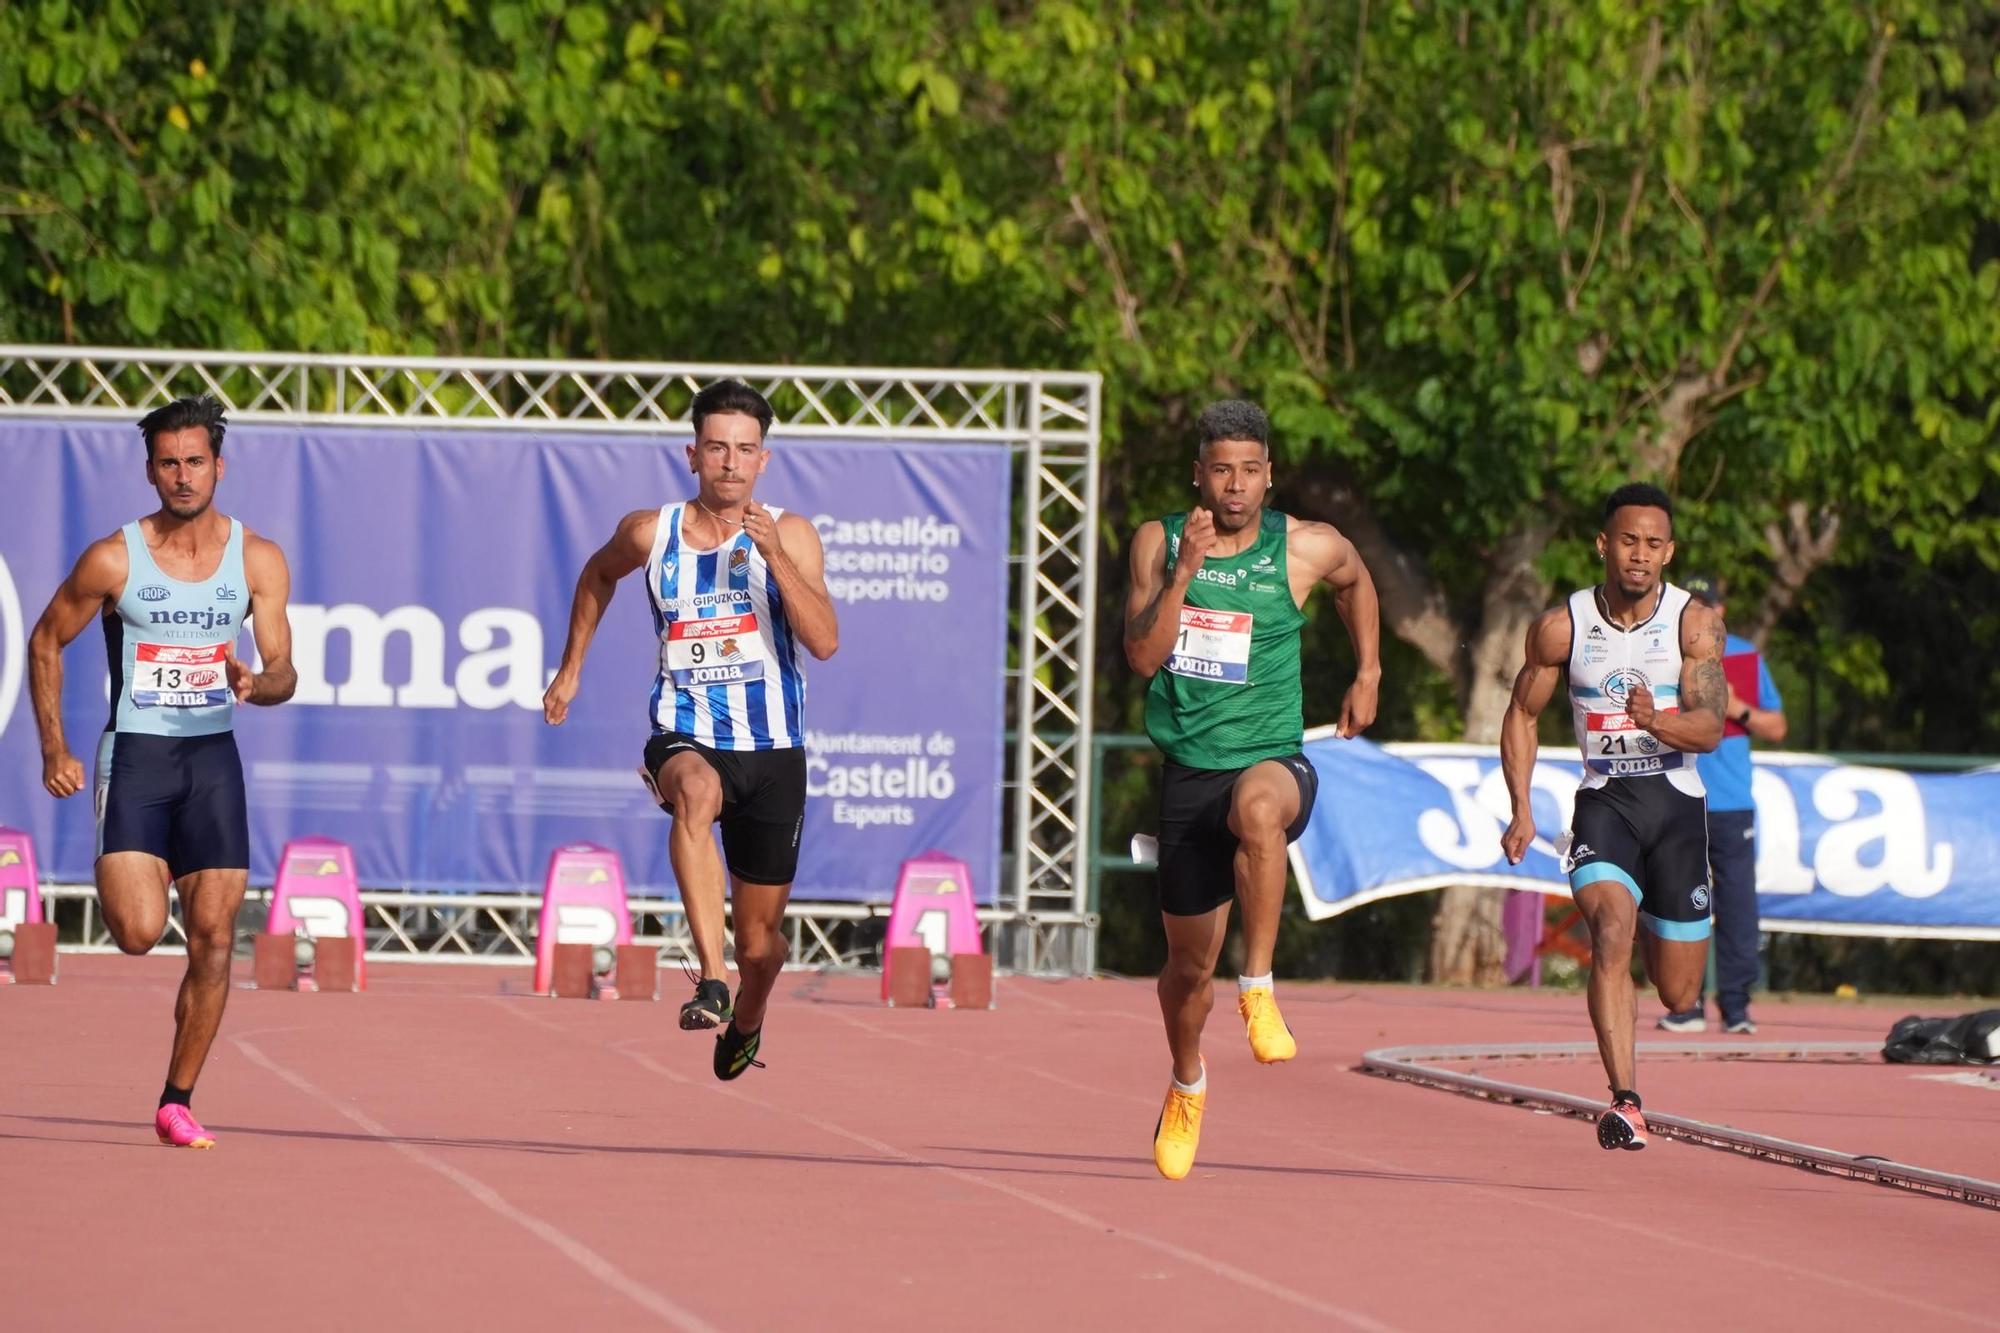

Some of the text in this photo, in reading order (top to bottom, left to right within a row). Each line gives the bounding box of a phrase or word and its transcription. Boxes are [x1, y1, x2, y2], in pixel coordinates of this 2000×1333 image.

[811, 513, 960, 547] Castellón
[824, 545, 949, 574] scenario
[1196, 568, 1237, 586] acsa
[139, 587, 170, 600] TROPS
[693, 591, 752, 607] GIPUZKOA
[150, 606, 231, 630] nerja
[163, 630, 220, 639] ATLETISMO
[691, 643, 705, 664] 9
[152, 667, 182, 689] 13
[926, 730, 955, 756] de
[1600, 734, 1627, 755] 21
[806, 757, 955, 799] Castelló
[833, 800, 914, 829] Esports
